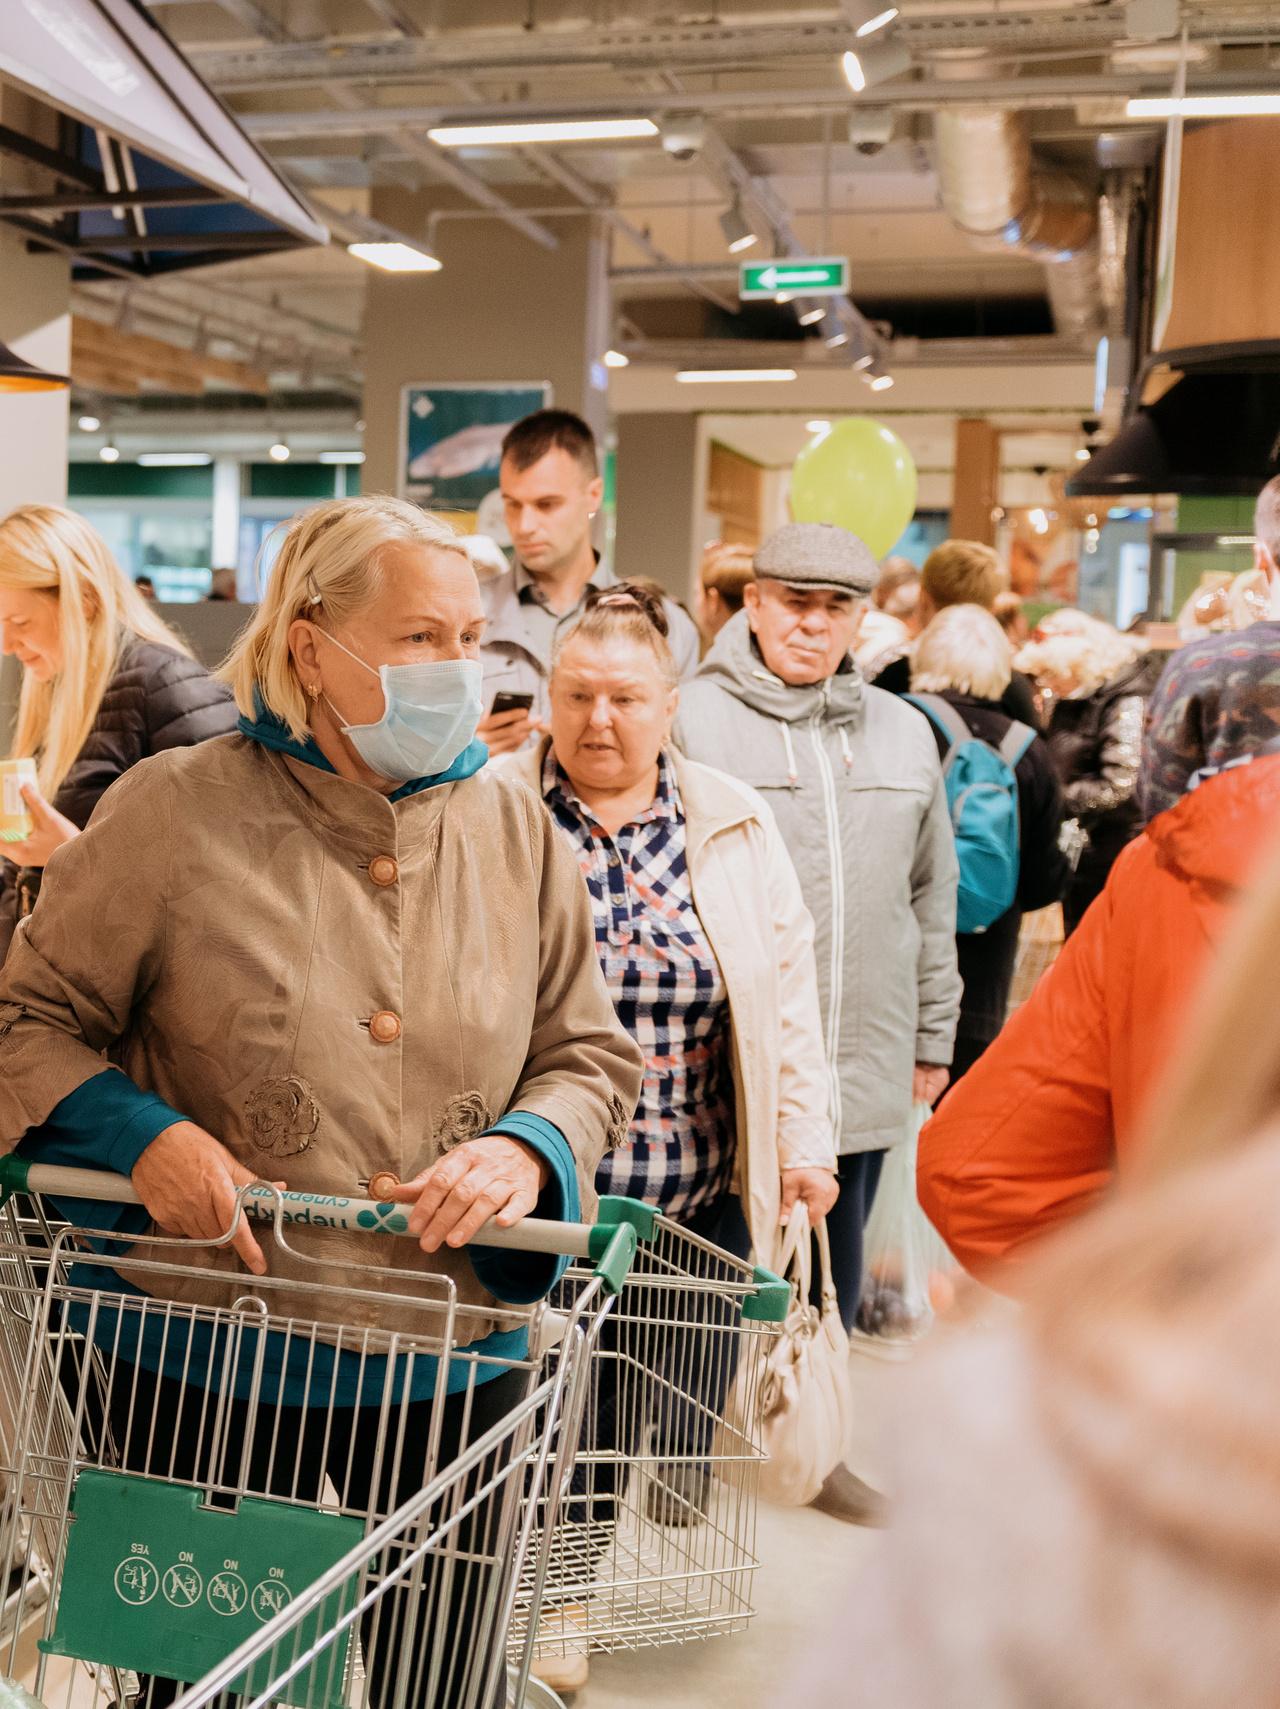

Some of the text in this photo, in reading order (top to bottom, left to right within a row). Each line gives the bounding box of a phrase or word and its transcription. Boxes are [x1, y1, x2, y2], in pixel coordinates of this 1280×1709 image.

[236, 1187, 349, 1207] супермар
[131, 1543, 149, 1555] YES
[178, 1551, 194, 1562] NO
[223, 1559, 238, 1570] NO
[269, 1567, 284, 1579] NO
